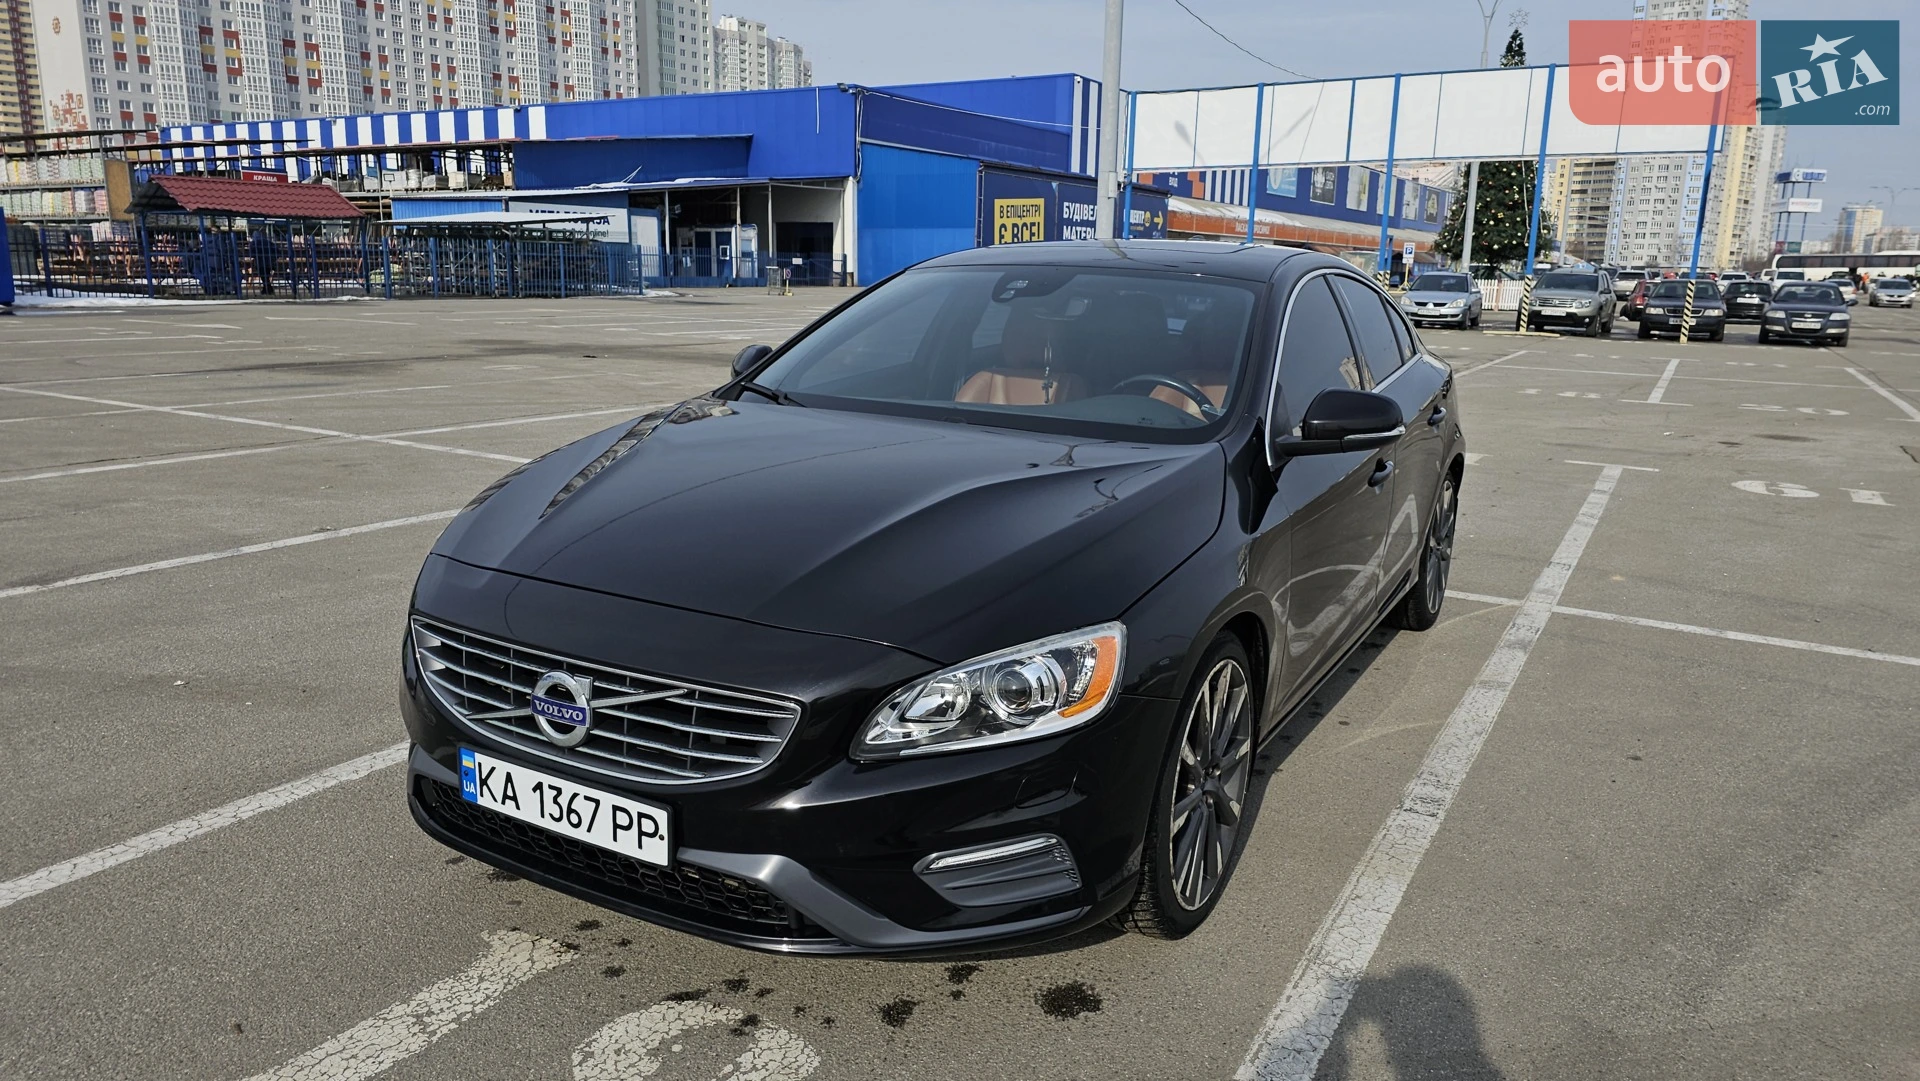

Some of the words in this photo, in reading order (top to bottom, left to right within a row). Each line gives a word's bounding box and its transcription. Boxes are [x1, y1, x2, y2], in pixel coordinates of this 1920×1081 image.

[1000, 205, 1004, 219] В
[1006, 204, 1041, 220] ЕПІЦЕНТРІ
[1063, 202, 1097, 222] БУДІВЕЛ
[533, 699, 584, 723] VOLVO
[464, 779, 476, 794] UA
[477, 762, 521, 811] KA
[531, 781, 601, 833] 1367
[611, 804, 660, 850] PP
